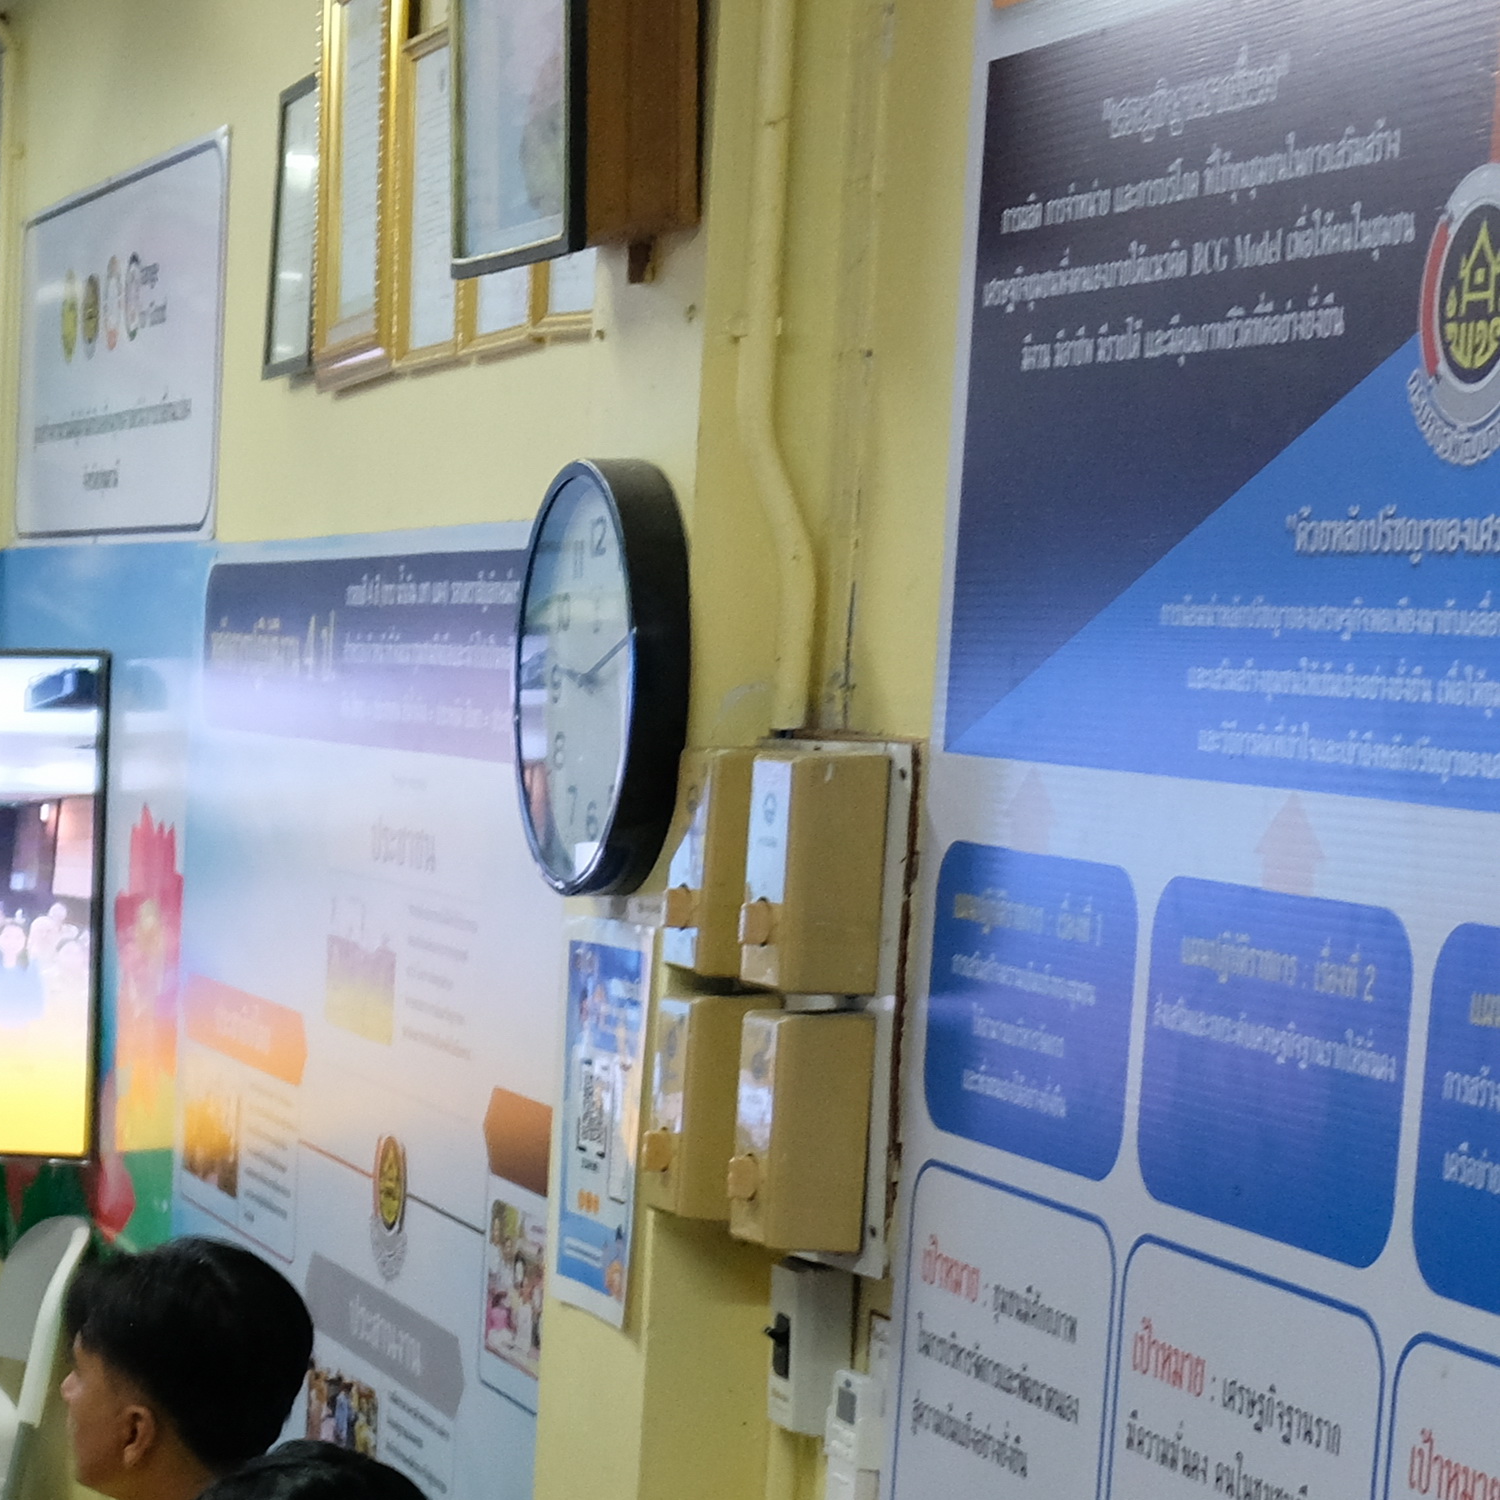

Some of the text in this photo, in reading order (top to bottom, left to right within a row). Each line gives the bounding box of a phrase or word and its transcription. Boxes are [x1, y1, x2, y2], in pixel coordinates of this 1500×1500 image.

[1191, 236, 1228, 277] BCG
[1233, 228, 1284, 272] Model
[1362, 965, 1376, 1003] 2
[1131, 1317, 1343, 1458] เป้าหมาย เศรษฐกิจฐานราก
[1125, 1417, 1210, 1487] มีความมั่นคง
